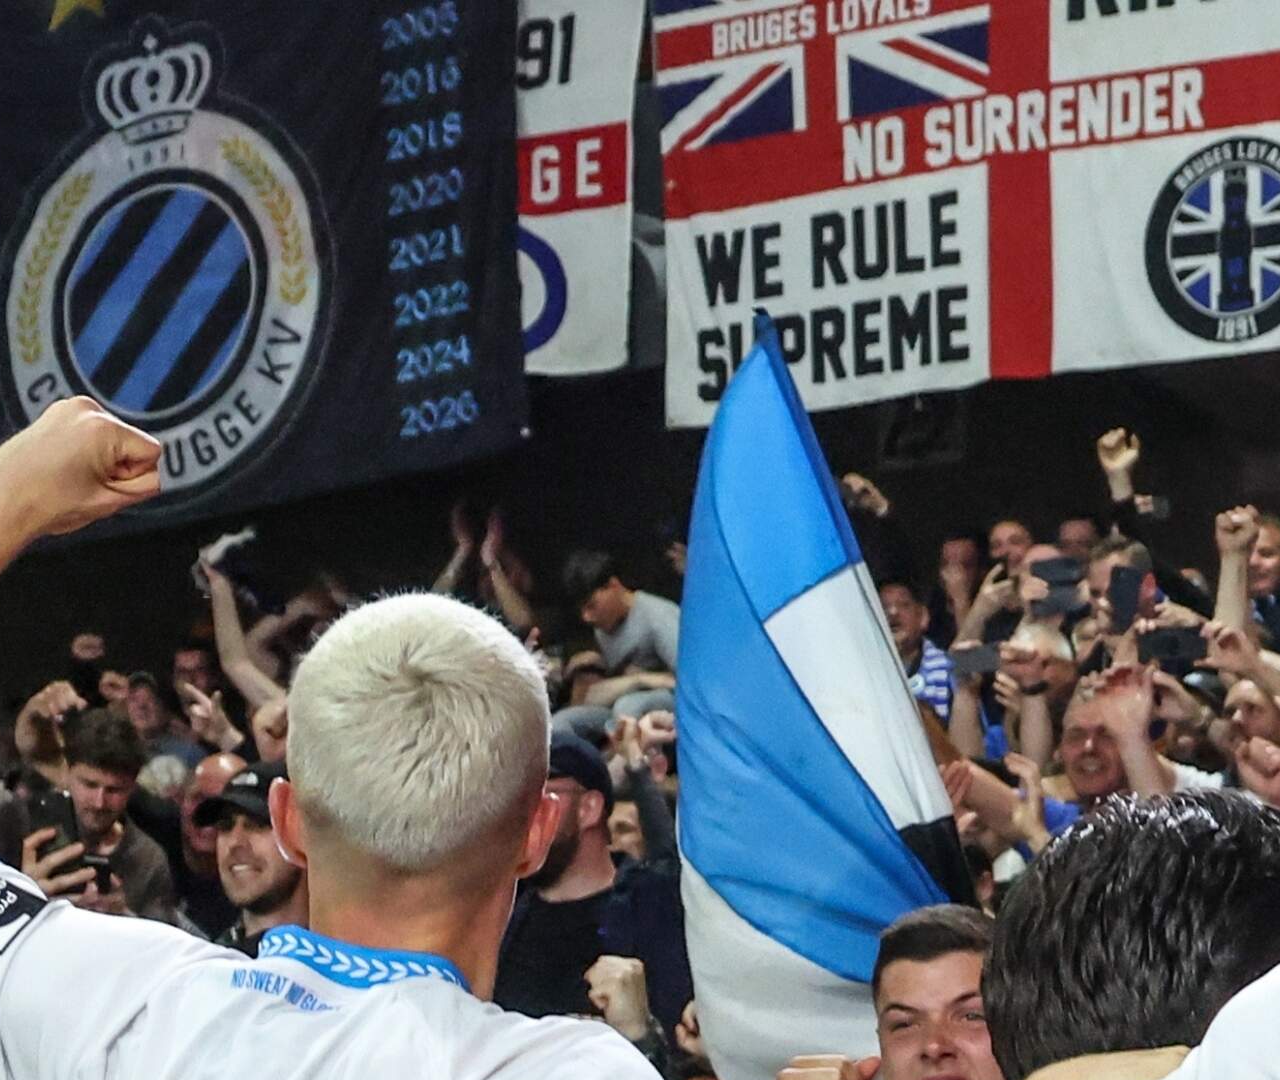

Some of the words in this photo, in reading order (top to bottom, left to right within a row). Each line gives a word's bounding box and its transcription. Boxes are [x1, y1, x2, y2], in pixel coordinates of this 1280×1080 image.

[712, 5, 816, 58] BRUGES
[842, 115, 905, 183] NO
[923, 67, 1206, 168] SURRENDER
[696, 222, 783, 307] WE
[811, 190, 961, 289] RULE
[163, 389, 264, 479] UGGE
[256, 316, 303, 386] KV
[246, 969, 290, 996] SWEAT
